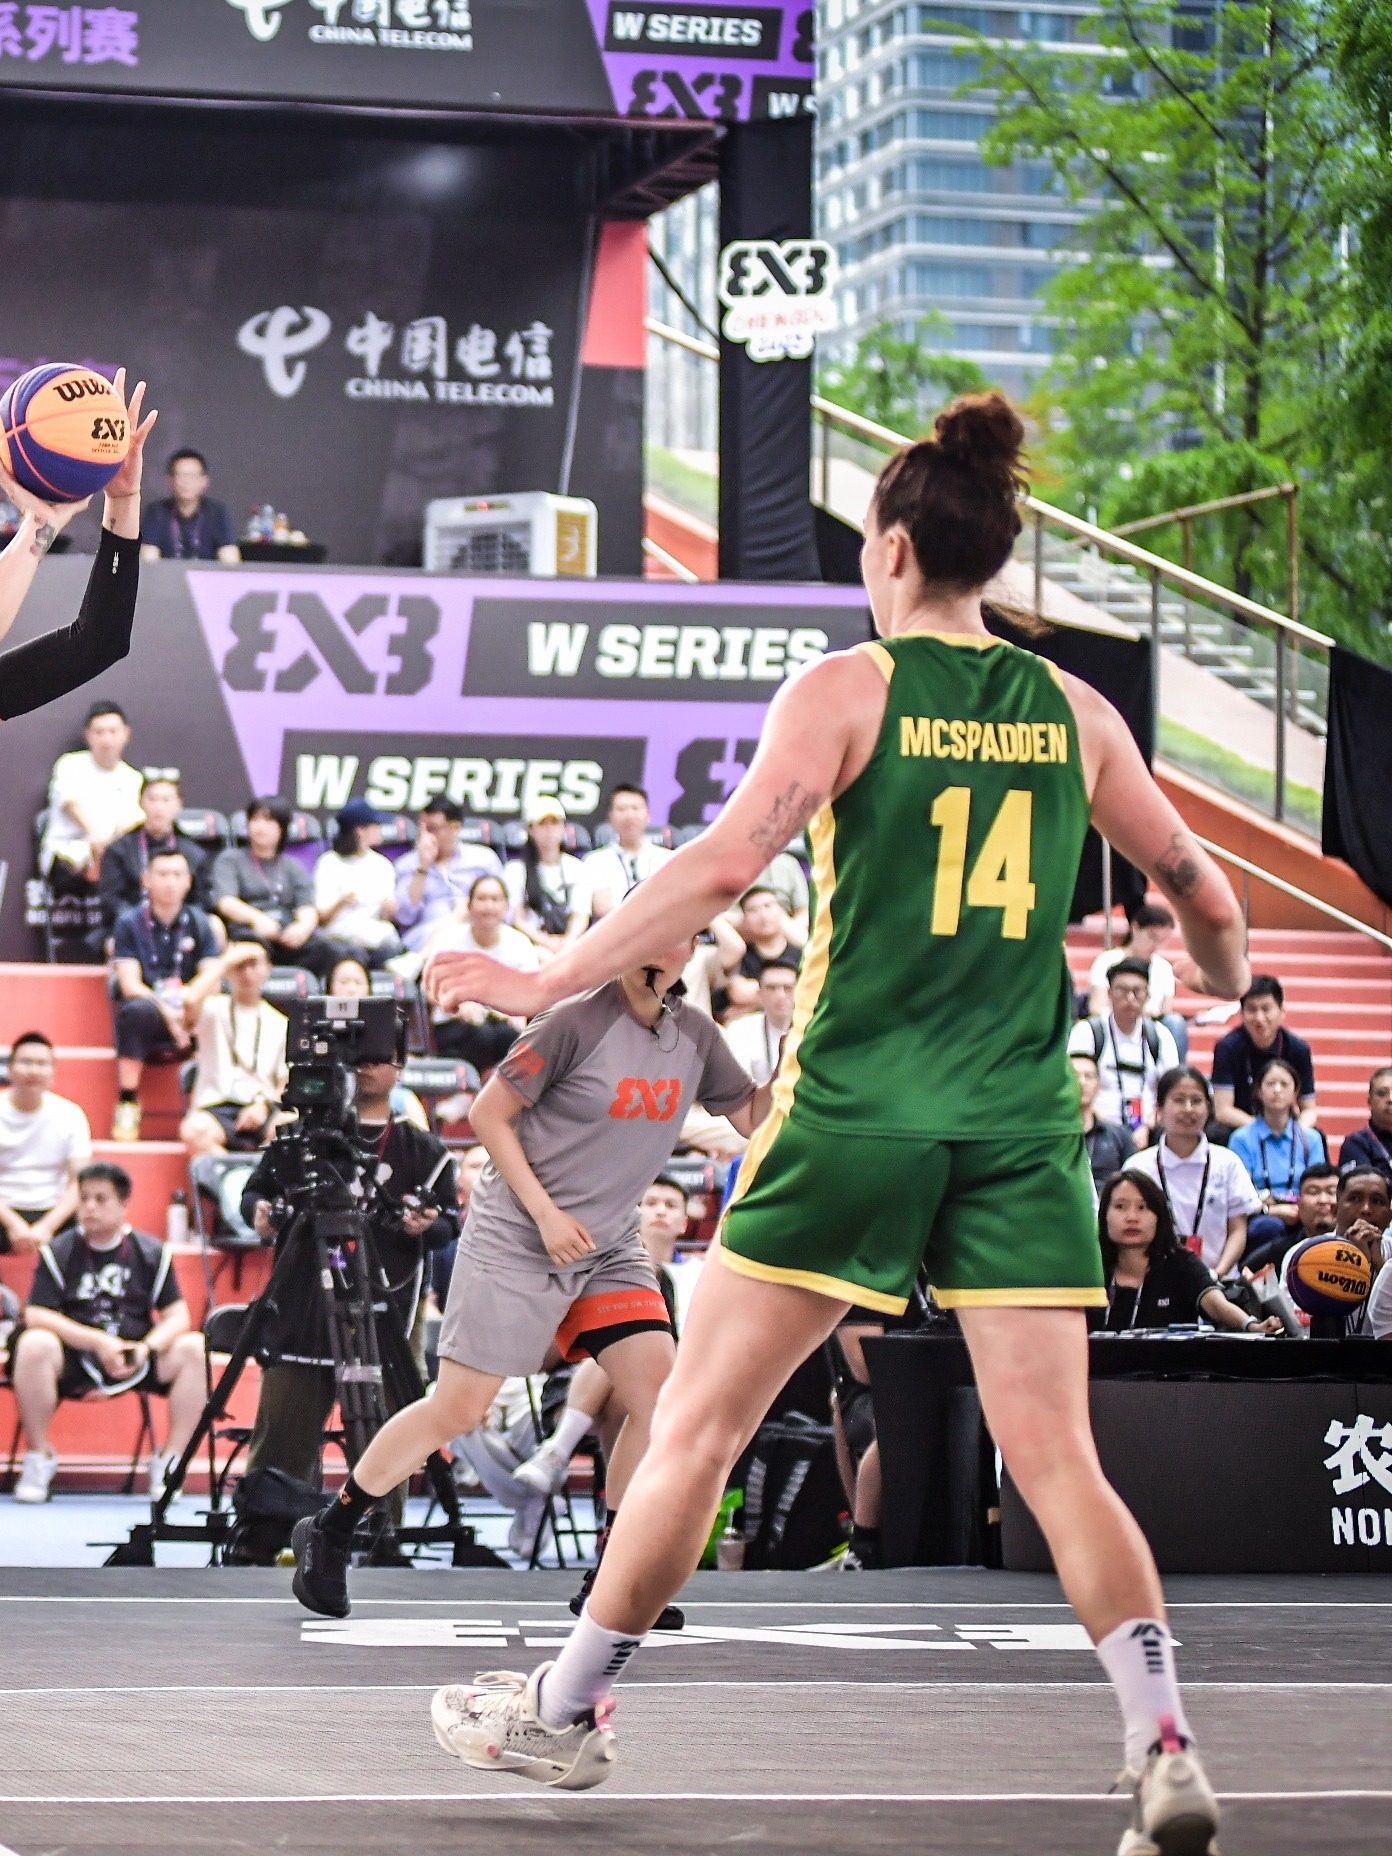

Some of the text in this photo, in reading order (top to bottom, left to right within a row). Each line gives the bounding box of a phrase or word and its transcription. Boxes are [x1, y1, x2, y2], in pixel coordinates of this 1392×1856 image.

[309, 25, 473, 52] CHINA TELECOM
[613, 11, 646, 41] W
[646, 13, 764, 47] SERIES
[345, 310, 555, 383] 中国电信
[344, 376, 554, 407] CHINA TELECOM
[526, 621, 830, 681] W SERIES
[899, 715, 1069, 764] MCSPADDEN
[295, 753, 360, 809] W
[367, 755, 604, 815] SERIES
[930, 786, 1036, 941] 14
[1318, 1270, 1367, 1296] Wilson
